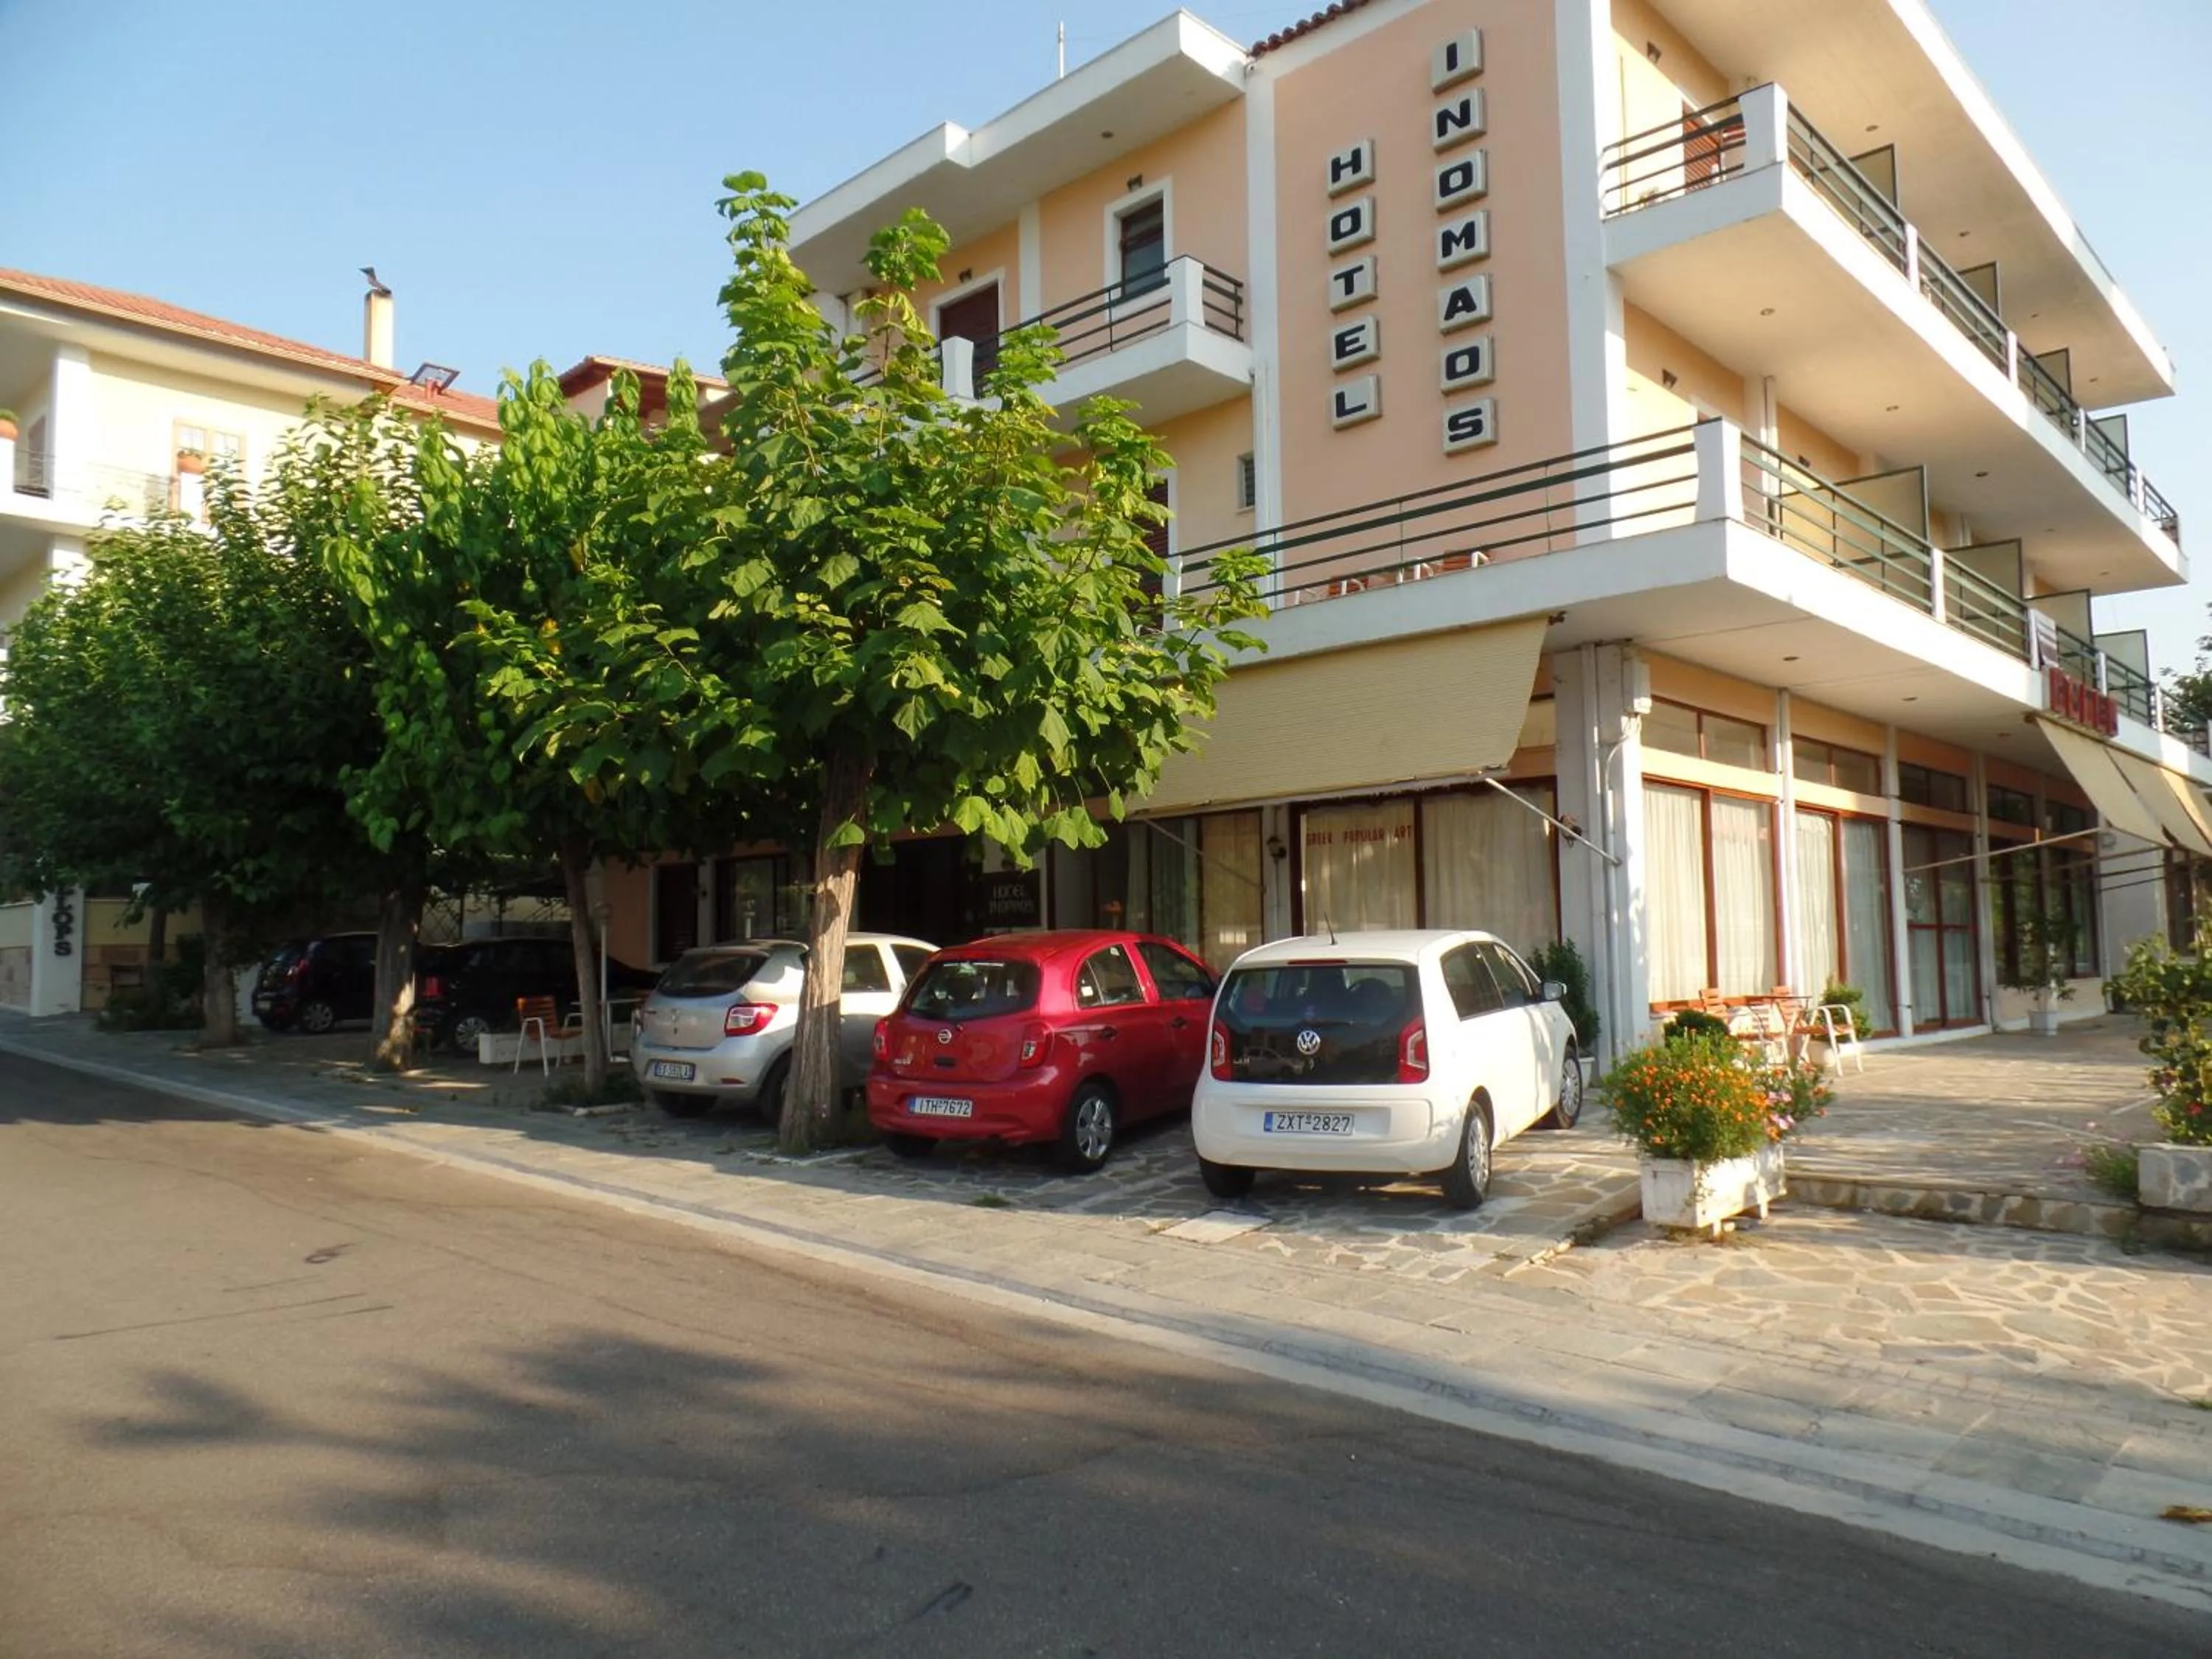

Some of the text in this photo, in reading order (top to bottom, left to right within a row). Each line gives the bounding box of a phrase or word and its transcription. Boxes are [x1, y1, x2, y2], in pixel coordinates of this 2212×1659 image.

[1331, 147, 1367, 418] HOTEL
[1436, 42, 1484, 442] INOMAOS
[1343, 828, 1385, 843] POPULAR
[1394, 825, 1411, 838] ART
